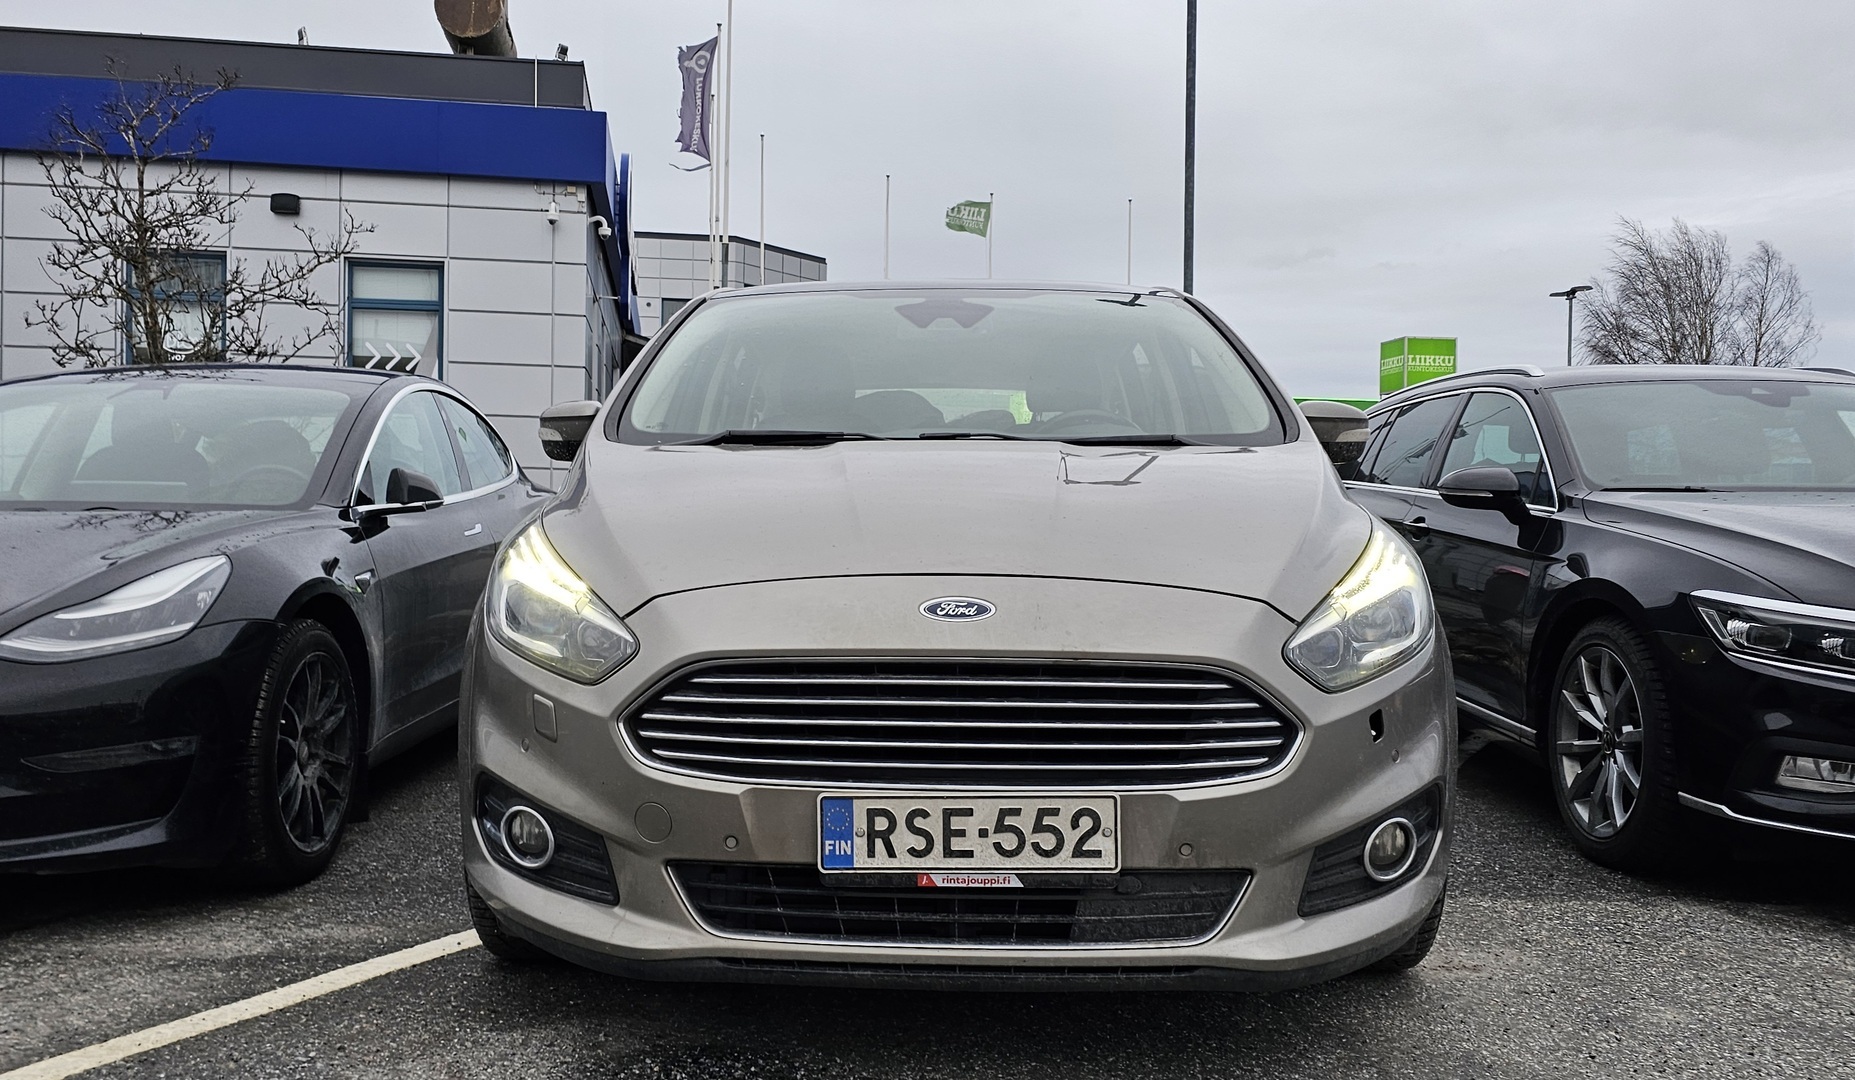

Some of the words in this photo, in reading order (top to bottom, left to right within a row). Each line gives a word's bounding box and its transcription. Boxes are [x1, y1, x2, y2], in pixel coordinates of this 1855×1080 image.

[690, 77, 703, 152] LUKKOKESKU
[1381, 355, 1404, 370] LIIKKU
[1407, 355, 1455, 367] LIIKKU
[937, 601, 978, 616] Ford
[865, 807, 1103, 859] RSE-552
[825, 840, 851, 856] FIN
[942, 875, 1011, 886] rintajouppi.fi
